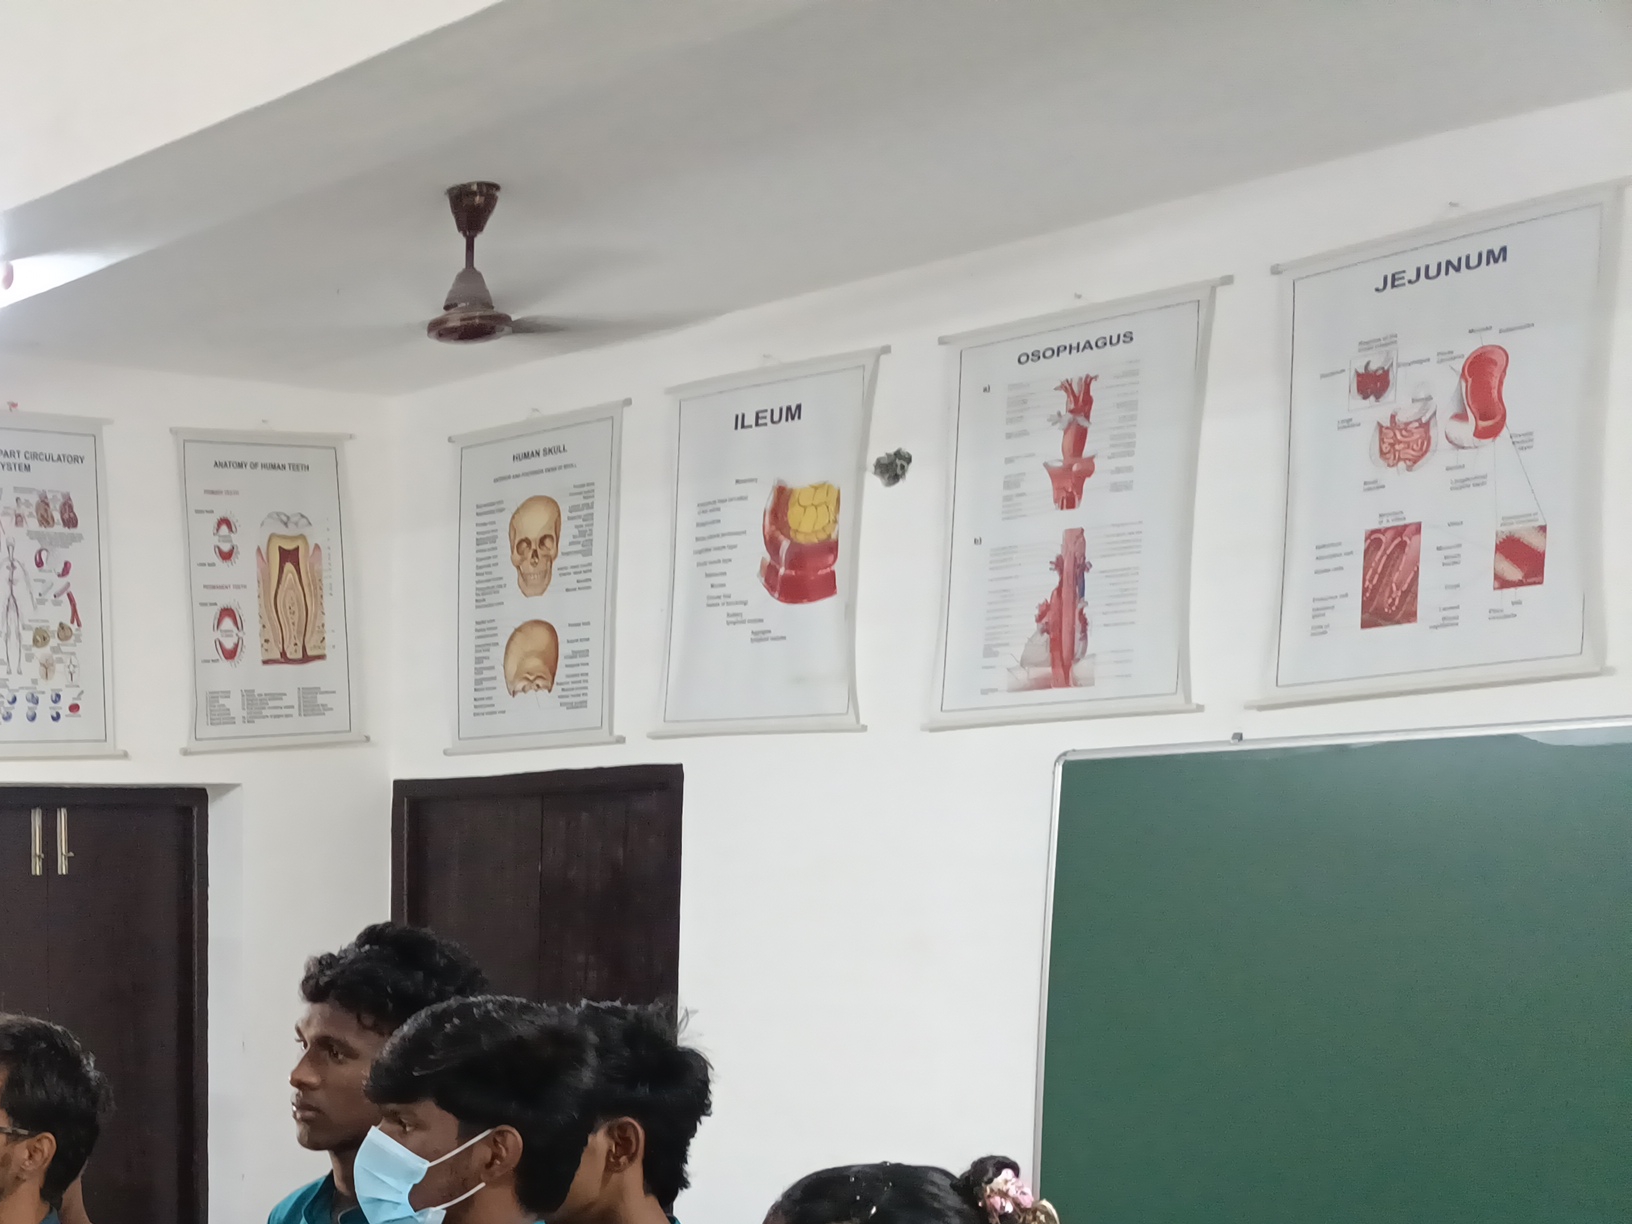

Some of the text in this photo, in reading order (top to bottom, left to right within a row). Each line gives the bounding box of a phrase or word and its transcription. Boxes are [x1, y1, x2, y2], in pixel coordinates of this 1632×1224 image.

[1374, 245, 1508, 292] JEJUNUM
[1017, 331, 1135, 365] OSOPHAGUS
[734, 402, 802, 431] ILEUM
[24, 450, 85, 465] CIRCULATORY
[512, 444, 568, 463] HUMAN SKULL
[213, 460, 310, 472] ANATOMY OF HUMAN TEETH
